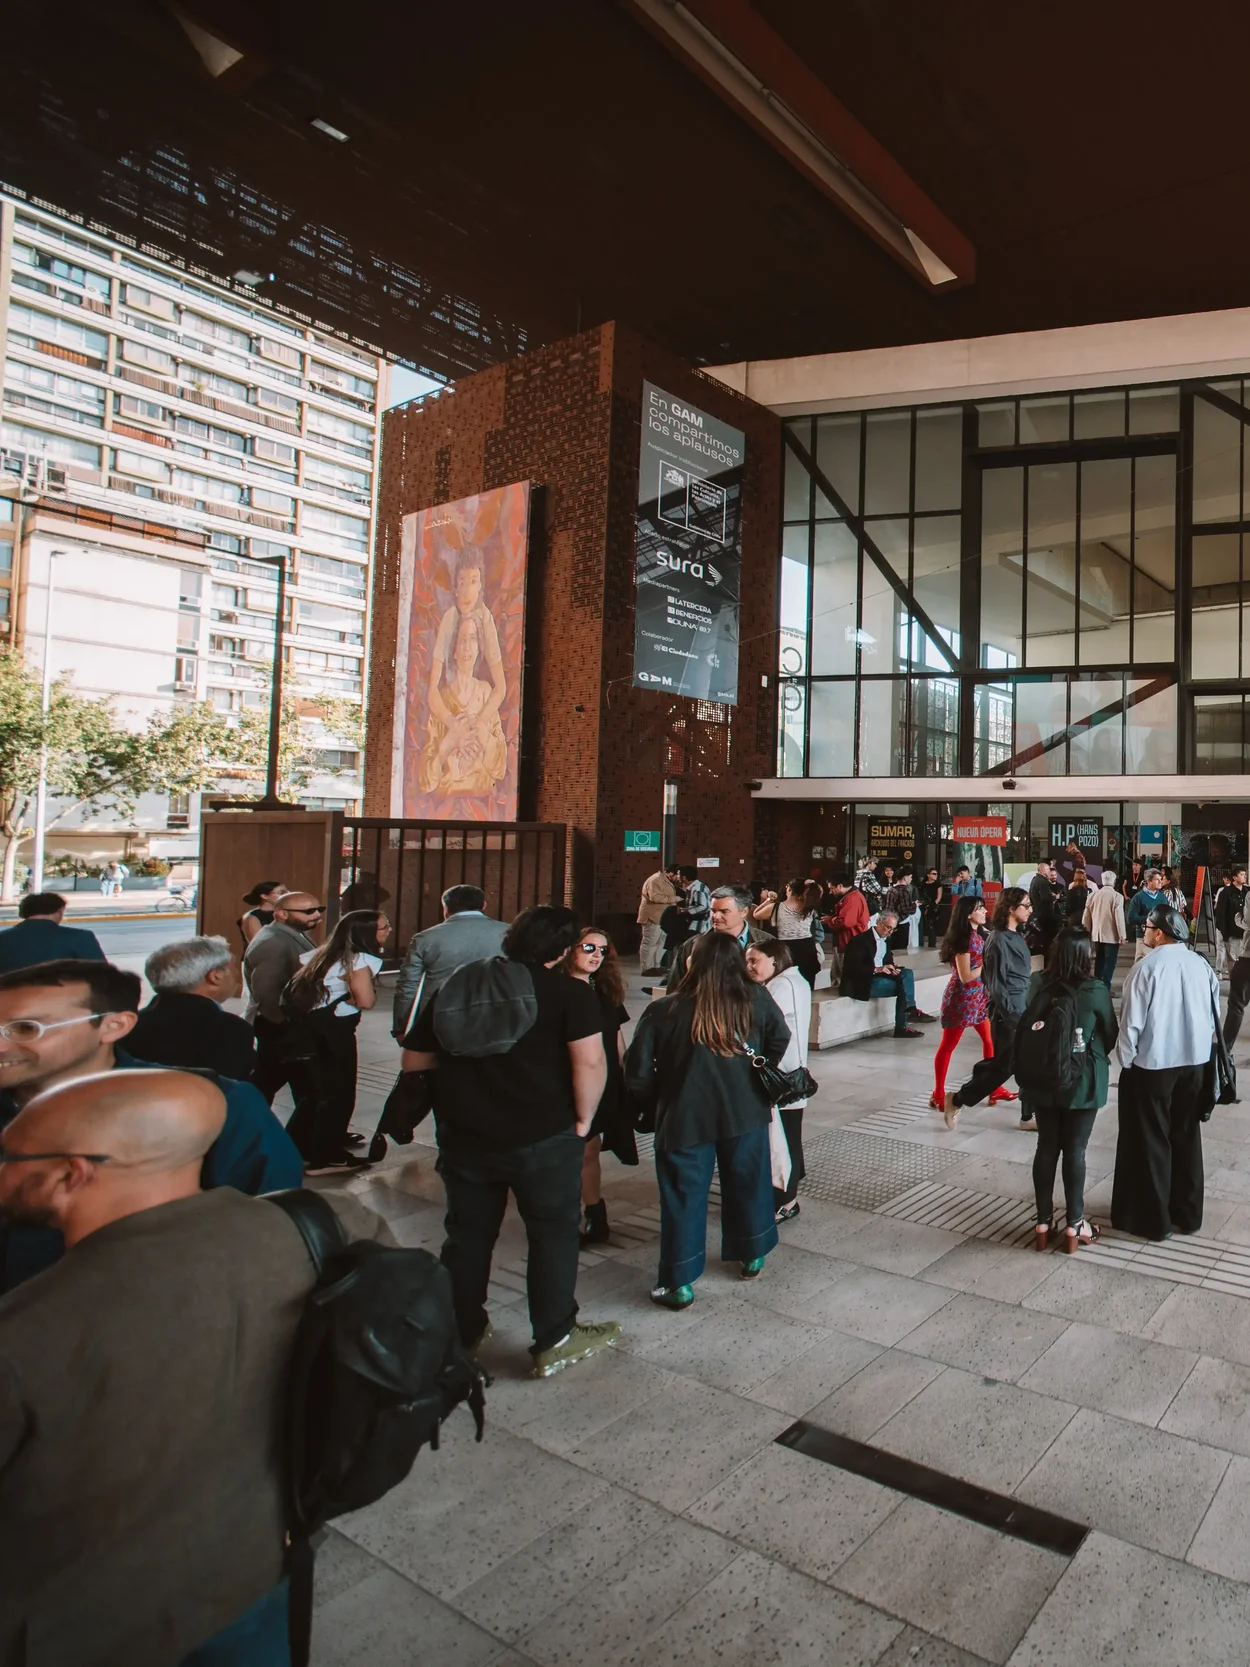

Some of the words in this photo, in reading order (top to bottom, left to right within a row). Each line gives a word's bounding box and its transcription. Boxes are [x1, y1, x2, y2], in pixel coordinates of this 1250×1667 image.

[650, 391, 667, 410] En
[671, 403, 703, 428] GAM
[649, 407, 740, 459] compartimos
[649, 416, 669, 436] los
[673, 431, 733, 467] aplausos
[656, 550, 704, 579] sura
[643, 577, 680, 593] Mediapartners
[675, 609, 713, 625] BENEFICIOS
[641, 630, 674, 642] Colaborador
[698, 625, 712, 634] 89.7
[871, 825, 915, 839] SUMAR,
[957, 826, 979, 838] NUEVA
[1077, 823, 1098, 836] (HANS
[1078, 835, 1099, 847] POZO)
